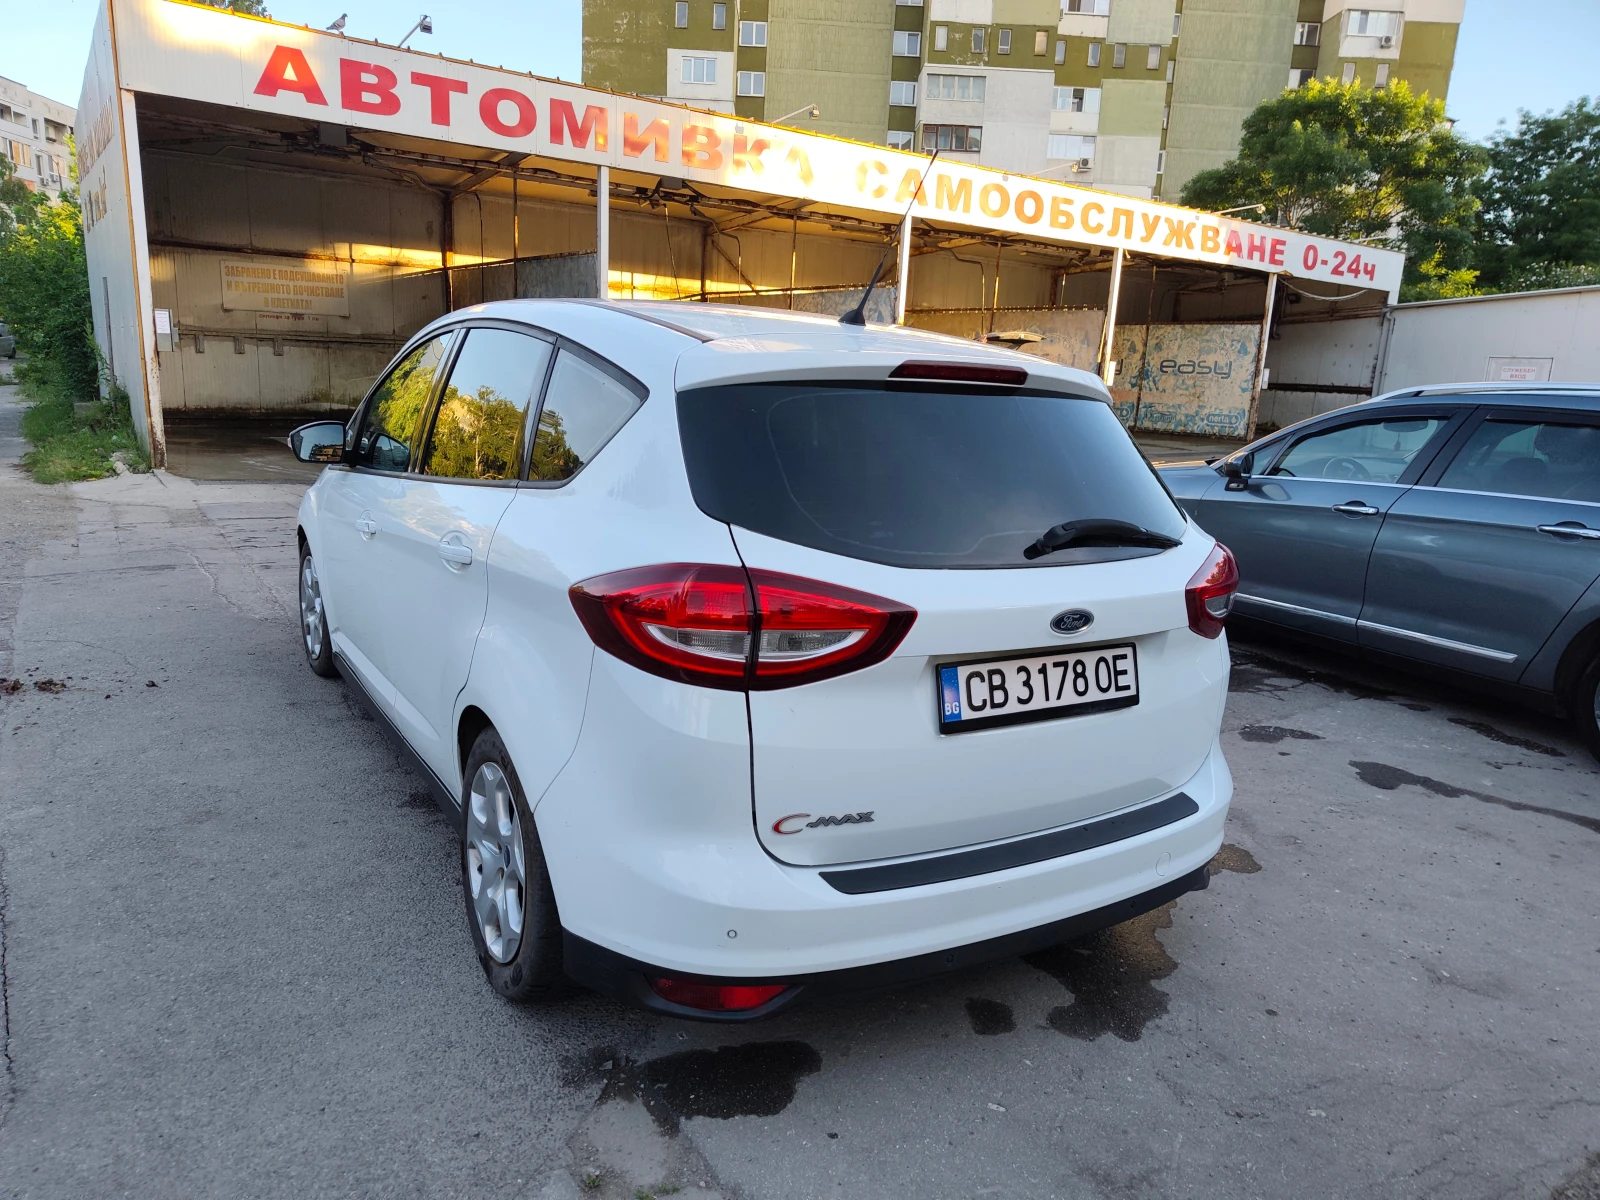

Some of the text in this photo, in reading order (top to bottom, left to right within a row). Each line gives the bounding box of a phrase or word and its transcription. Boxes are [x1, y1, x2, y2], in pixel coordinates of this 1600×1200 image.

[253, 45, 1376, 281] АВТОМИВКА САМООБСЛУЖВАНЕ 0-24ч
[225, 265, 344, 285] ЗАБРАНЕНО Е ПОДСУШАВАНЕТО
[227, 280, 344, 299] И ВЪТРЕШНОТО ПОЧИСТВАНЕ
[264, 297, 269, 308] В
[1159, 358, 1233, 379] easy
[1208, 414, 1229, 423] nerta
[1060, 614, 1086, 629] Ford
[966, 668, 1009, 712] CB
[1016, 659, 1089, 705] 3178
[944, 701, 960, 716] BG
